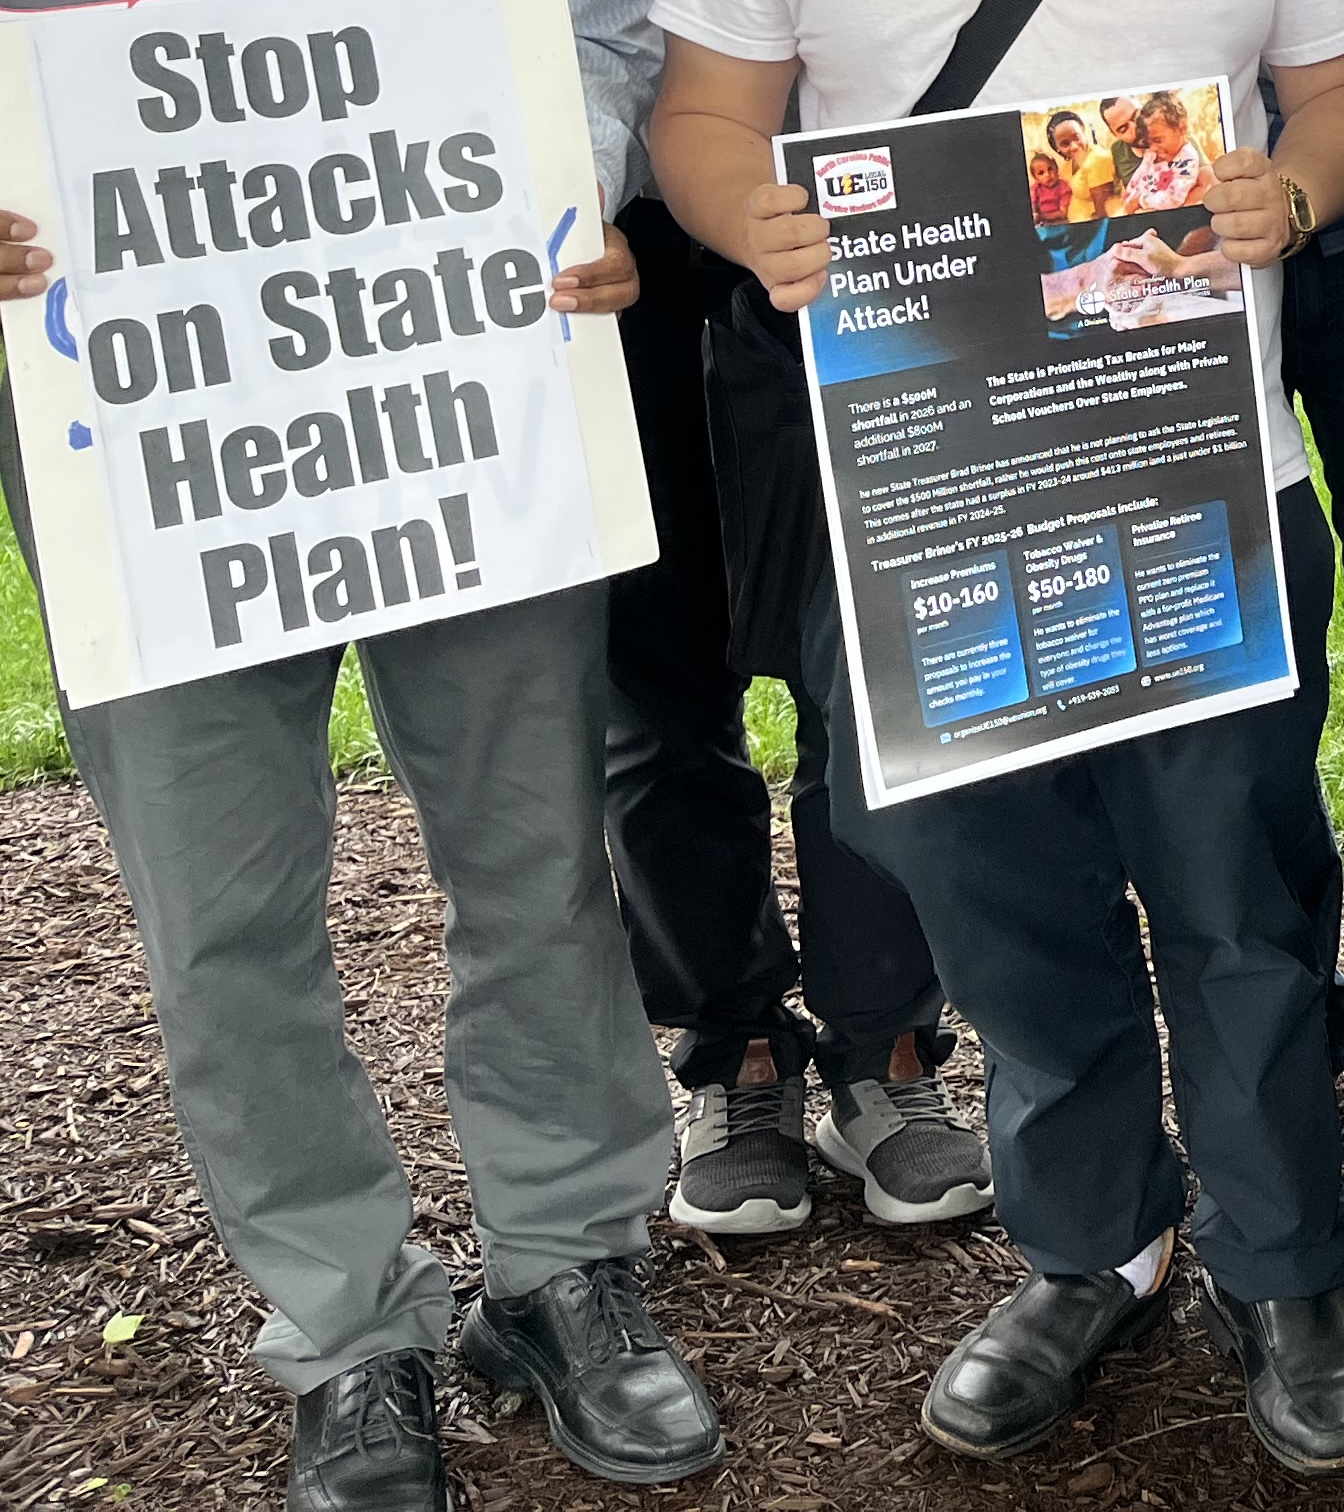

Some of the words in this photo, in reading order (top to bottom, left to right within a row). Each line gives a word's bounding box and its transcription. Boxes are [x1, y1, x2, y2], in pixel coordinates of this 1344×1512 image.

[130, 24, 380, 133] Stop
[92, 129, 504, 276] Attacks
[825, 230, 896, 261] State
[901, 212, 990, 248] Health
[829, 270, 889, 297] Plan
[894, 254, 976, 285] Under
[836, 294, 929, 335] Attack!
[86, 301, 230, 405] on
[259, 247, 548, 372] State
[139, 369, 500, 530] Health
[201, 493, 481, 651] Plan!
[913, 580, 998, 619] $10-160
[1027, 564, 1110, 602] $50-180
